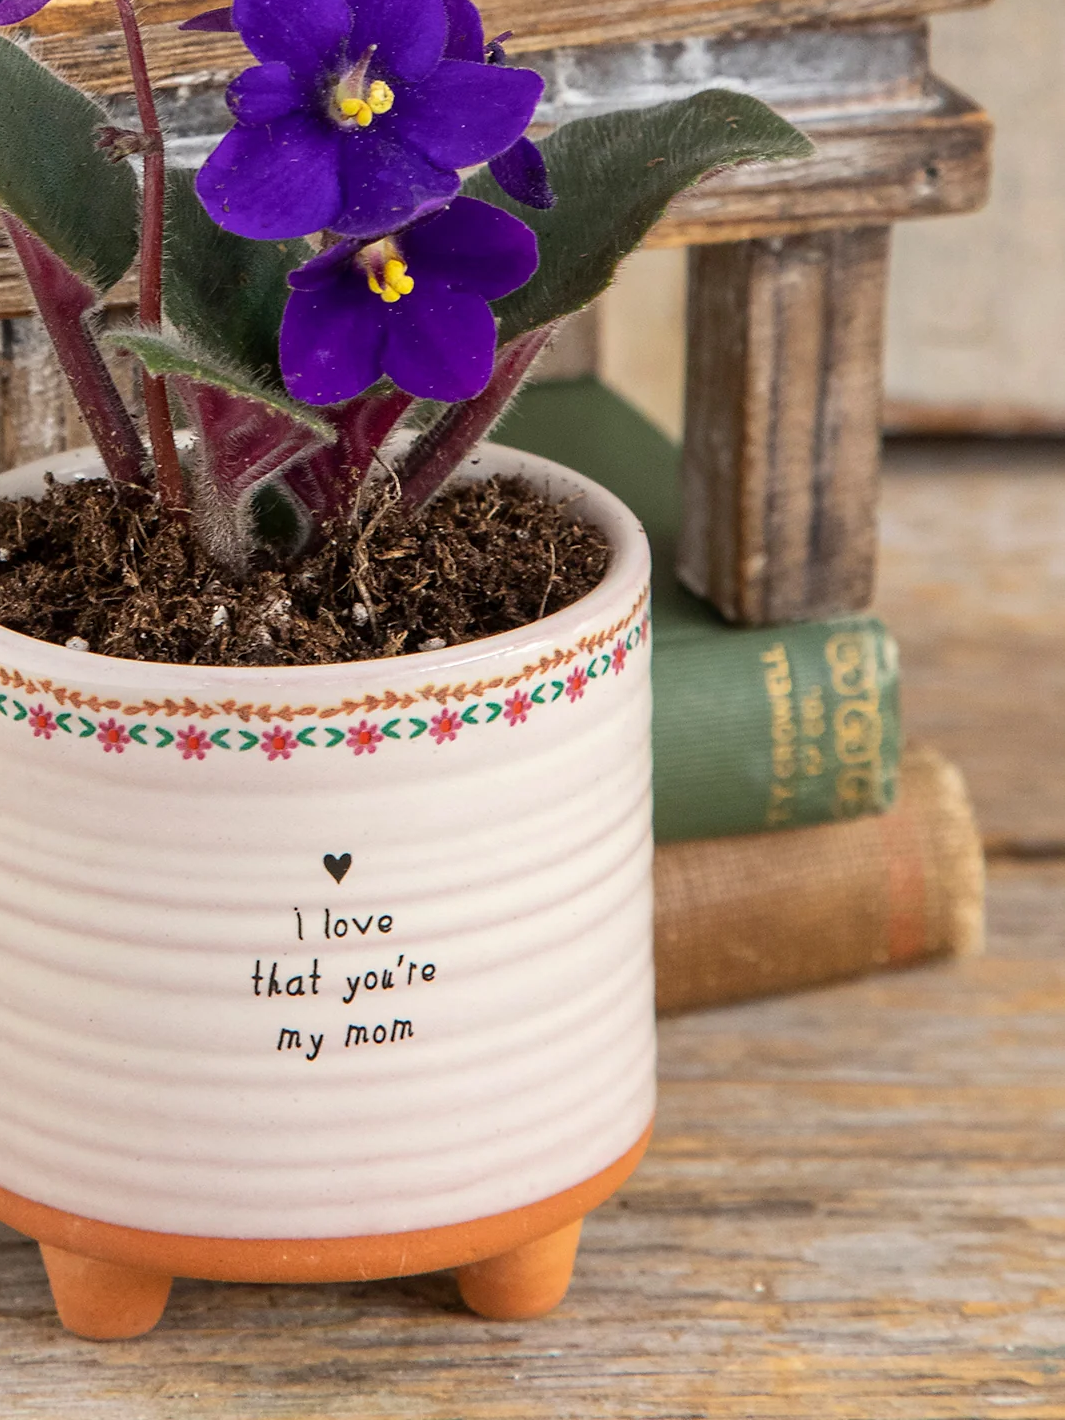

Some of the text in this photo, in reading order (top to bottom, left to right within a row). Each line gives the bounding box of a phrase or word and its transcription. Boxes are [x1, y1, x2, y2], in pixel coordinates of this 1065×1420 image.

[324, 908, 393, 940] love
[251, 954, 436, 1005] that you're
[277, 1018, 414, 1061] my mom
